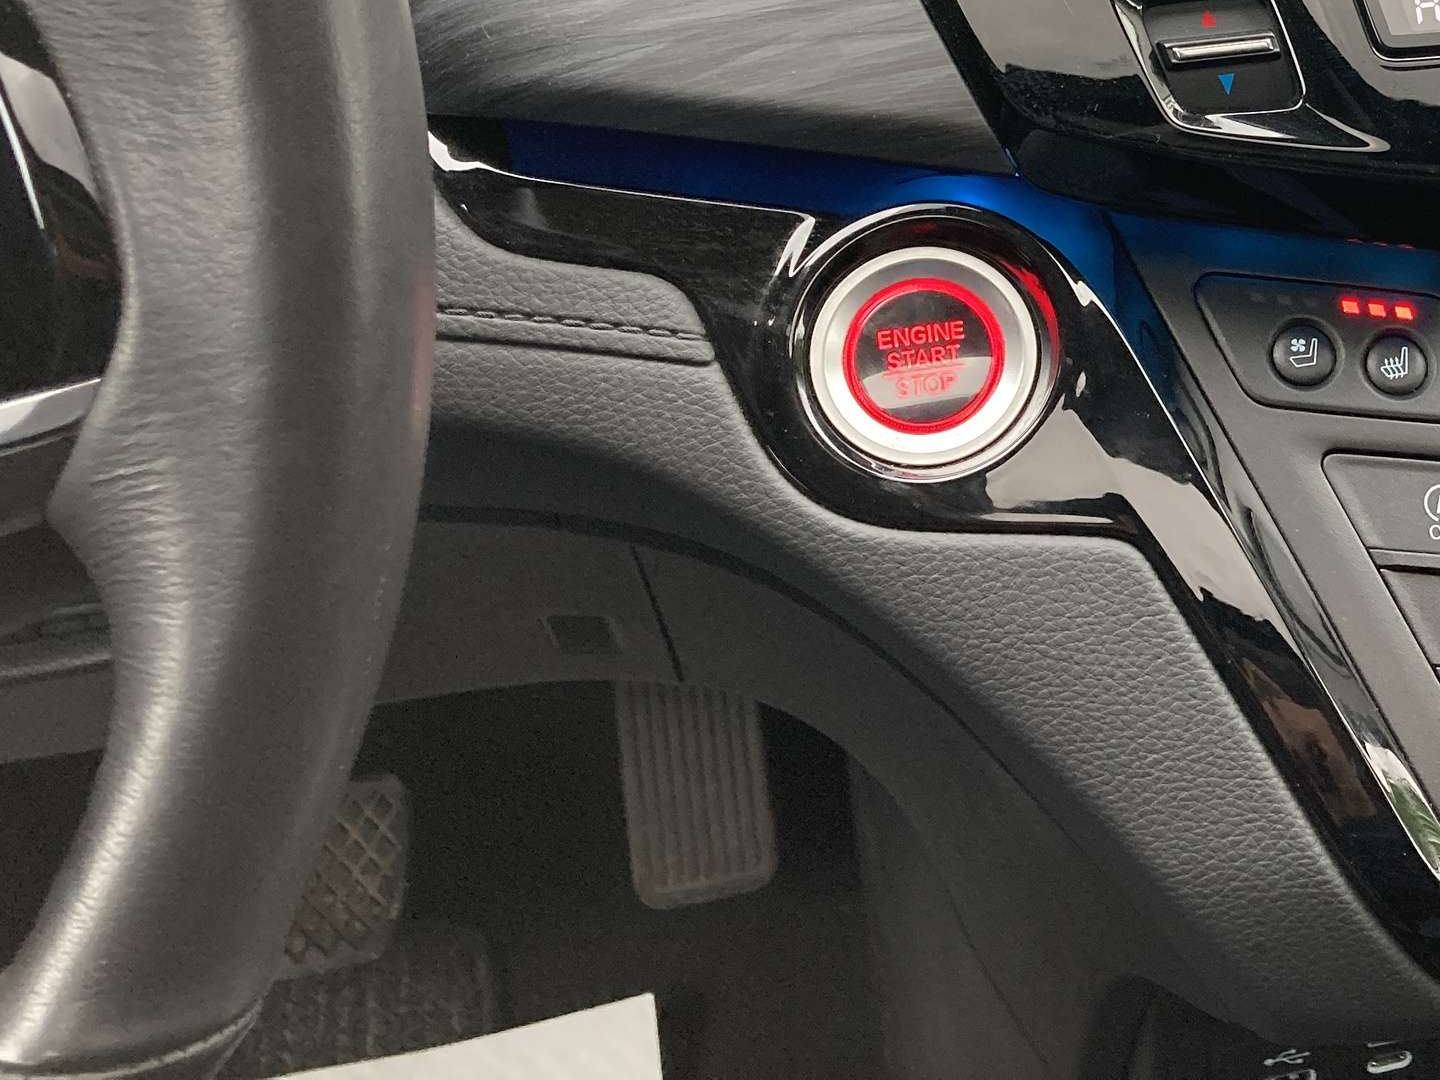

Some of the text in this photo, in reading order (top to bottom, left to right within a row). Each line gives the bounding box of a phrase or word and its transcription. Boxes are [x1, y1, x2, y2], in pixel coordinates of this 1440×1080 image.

[877, 320, 965, 350] ENGINE
[887, 343, 960, 370] START
[897, 373, 955, 399] STOP
